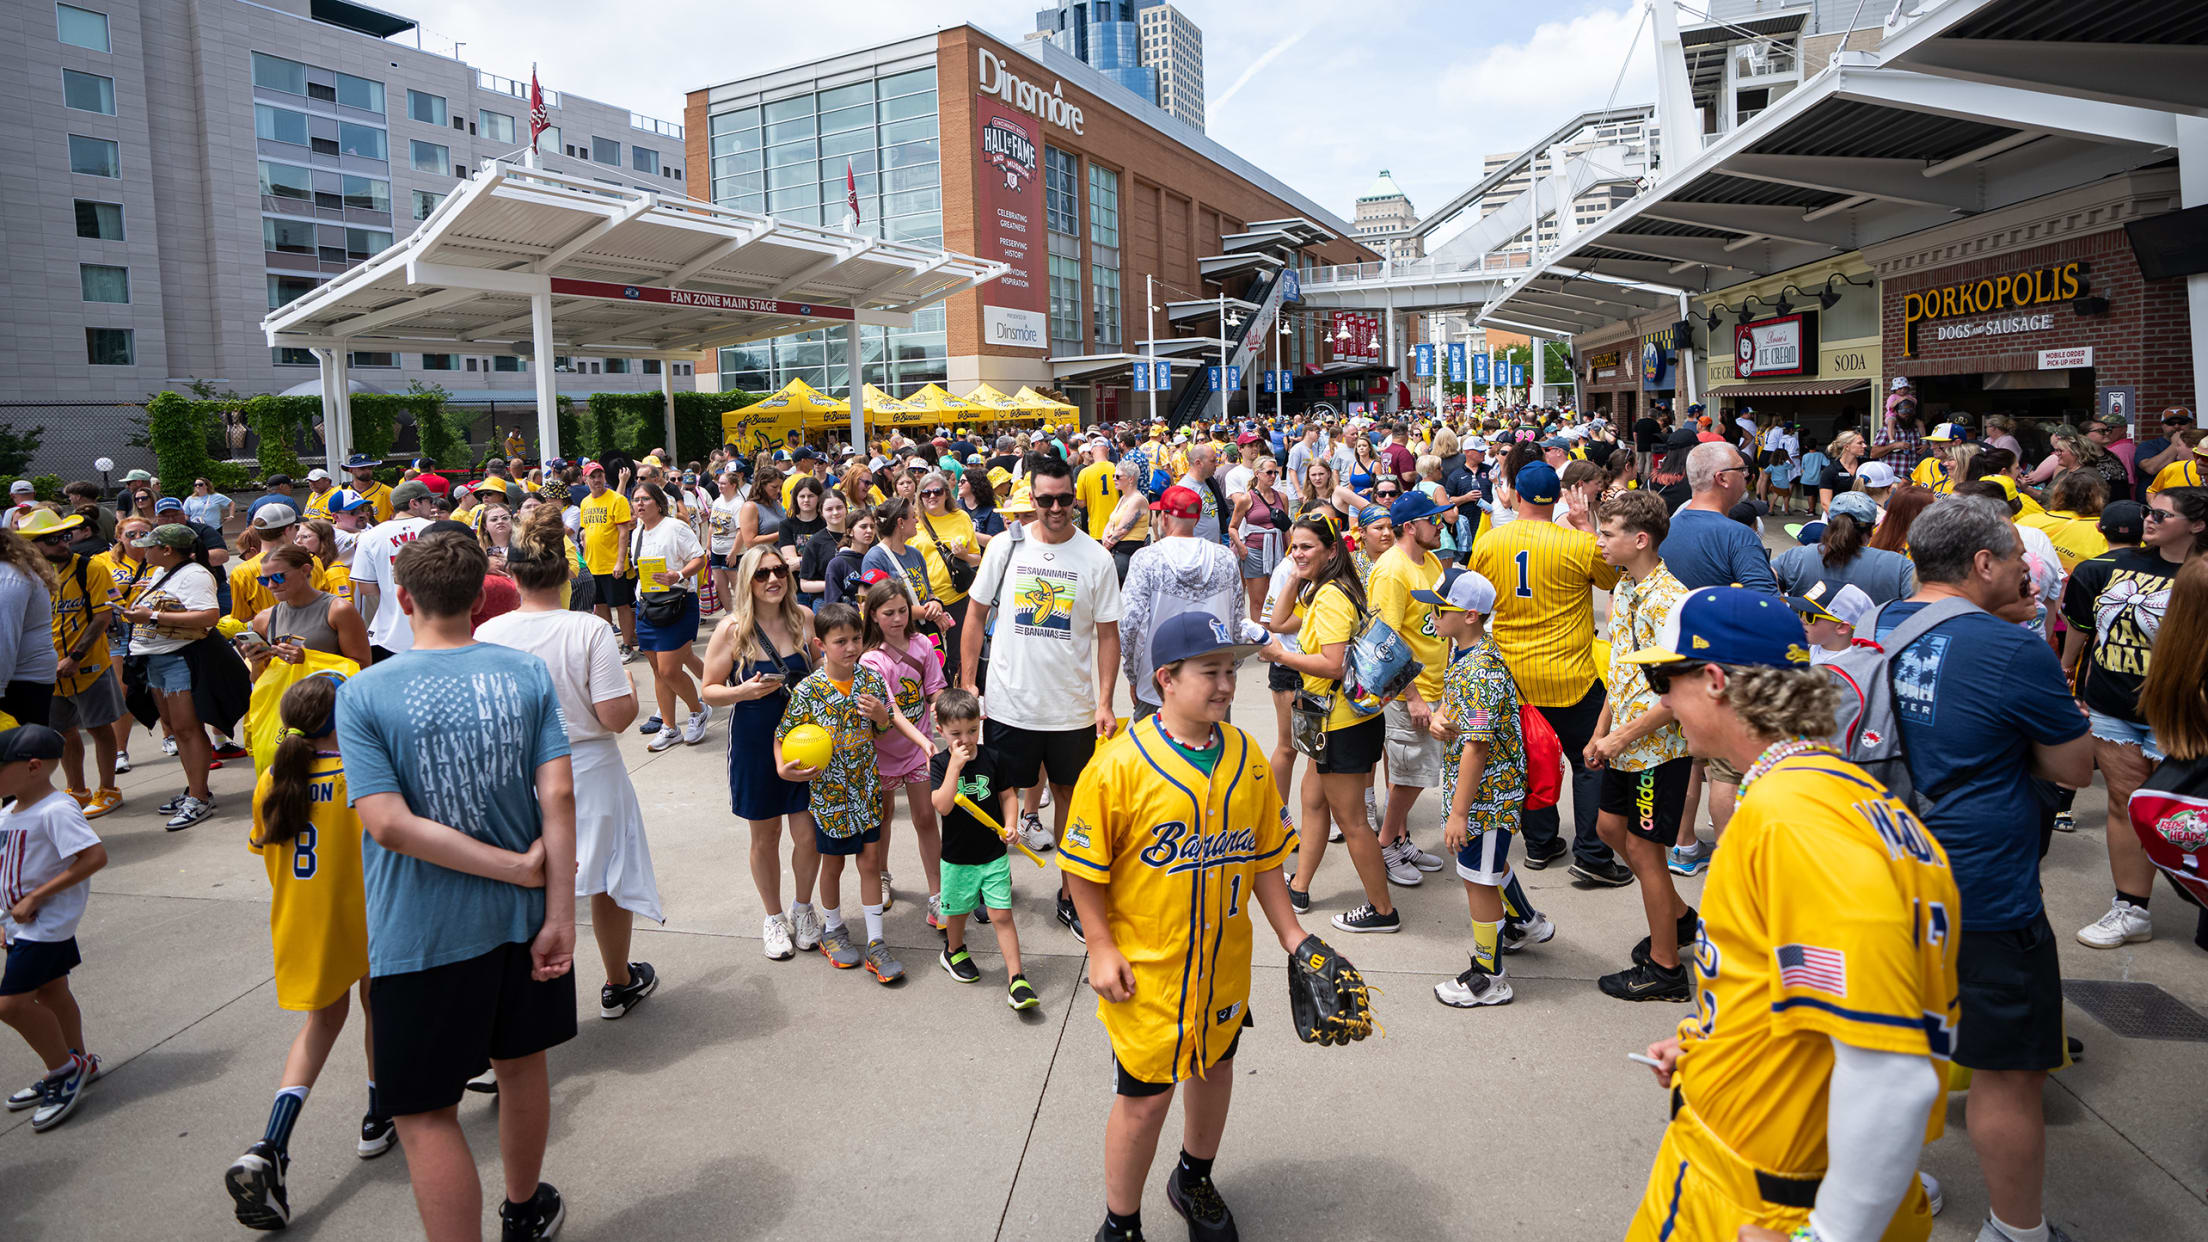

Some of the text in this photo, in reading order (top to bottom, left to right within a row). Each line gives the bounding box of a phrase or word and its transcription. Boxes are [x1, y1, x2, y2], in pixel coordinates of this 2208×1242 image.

[979, 47, 1084, 136] Dinsmore
[984, 127, 1009, 155] HALL
[1012, 135, 1035, 169] FAME
[994, 154, 1030, 179] AND MUSEUM
[997, 208, 1028, 223] CELEBRATING
[1000, 219, 1026, 233] GREATNESS
[1000, 237, 1028, 250] PRESERVING
[1004, 249, 1024, 260] HISTORY
[1002, 276, 1029, 288] INSPIRATION
[671, 290, 778, 312] FAN ZONE MAIN STAGE
[1903, 263, 2079, 357] PORKOPOLIS
[997, 322, 1037, 342] Dinsmore
[1938, 314, 2051, 341] DOGS AND SAUSAGE
[1759, 345, 1796, 366] ICE CREAM
[1834, 353, 1866, 372] SODA
[2046, 351, 2066, 359] MOBILE
[2046, 357, 2084, 366] PICK-UP HERE
[1710, 365, 1736, 380] ICE CRE
[1515, 430, 1535, 442] 99
[1100, 474, 1109, 495] 1
[1026, 566, 1068, 579] SAVANNAH
[1515, 550, 1533, 598] 1
[1024, 627, 1059, 639] BANANAS
[2170, 831, 2207, 843] HEADS
[294, 821, 317, 880] 8
[1228, 874, 1242, 918] 1
